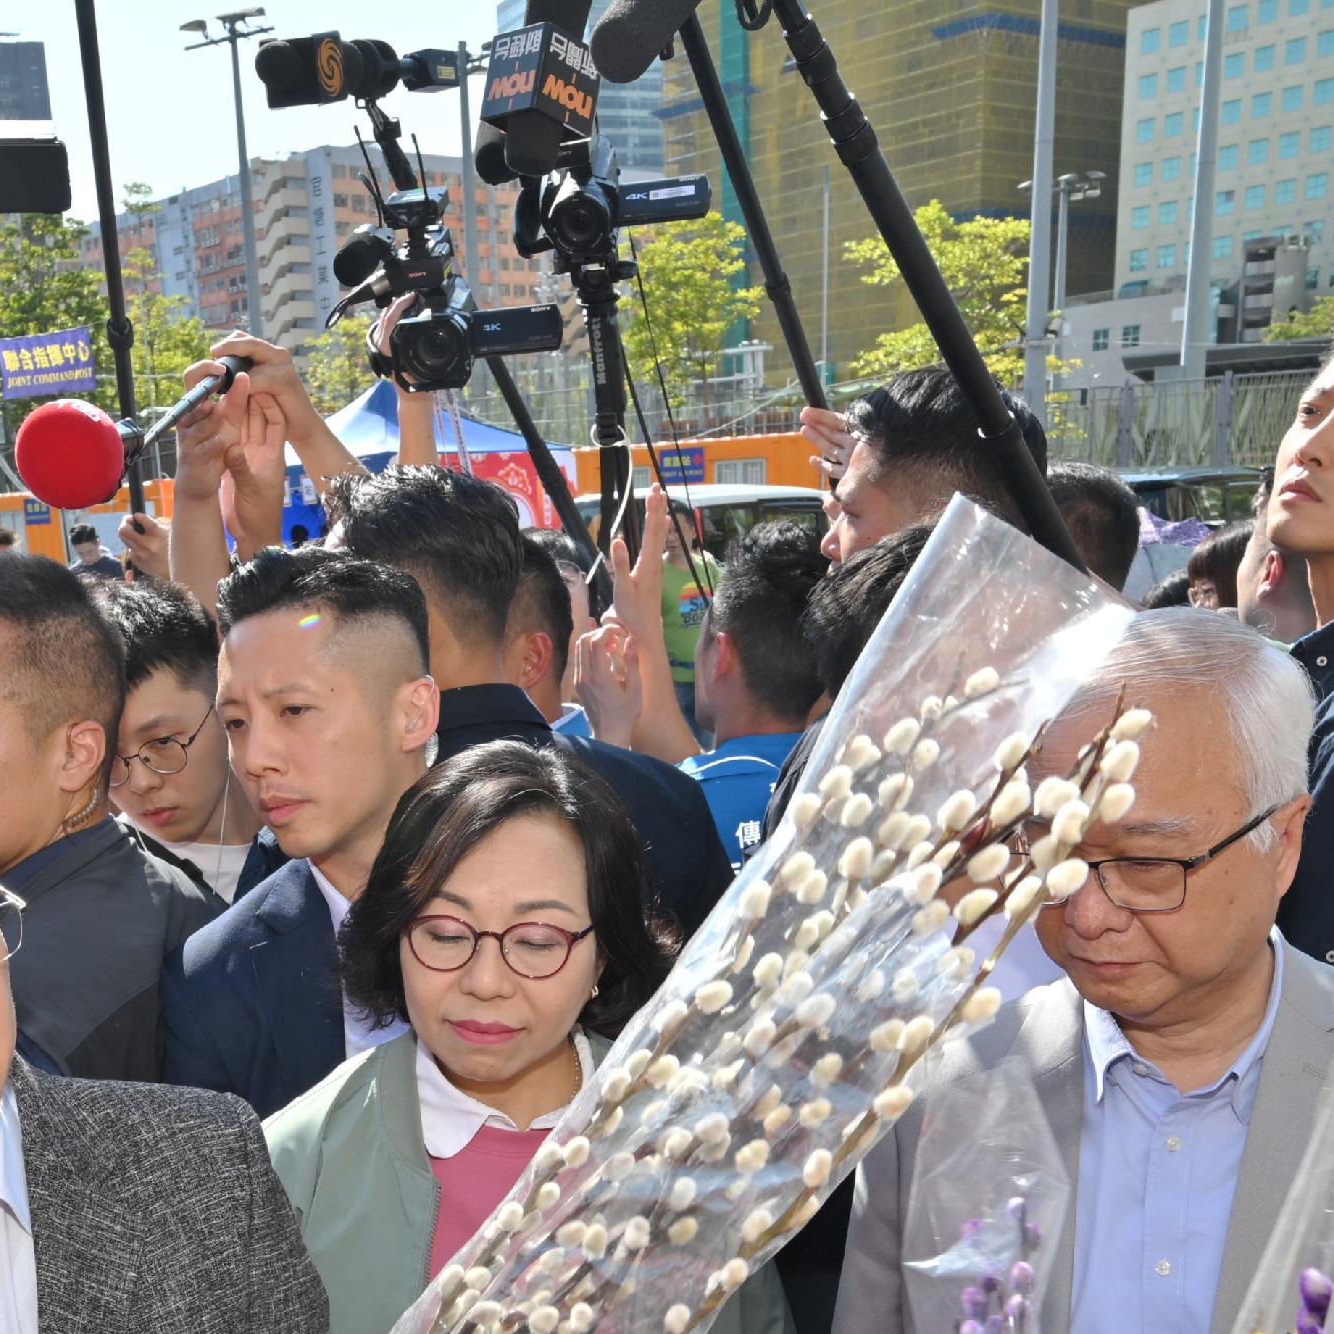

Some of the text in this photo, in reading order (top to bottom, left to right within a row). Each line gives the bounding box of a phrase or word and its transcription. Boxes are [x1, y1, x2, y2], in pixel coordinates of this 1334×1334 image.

[625, 192, 648, 200] 4K
[483, 322, 502, 331] 4K
[2, 340, 90, 373] 聯合指揮中心
[592, 316, 607, 385] Manfrott
[8, 366, 92, 388] JOINT COMMAND POST
